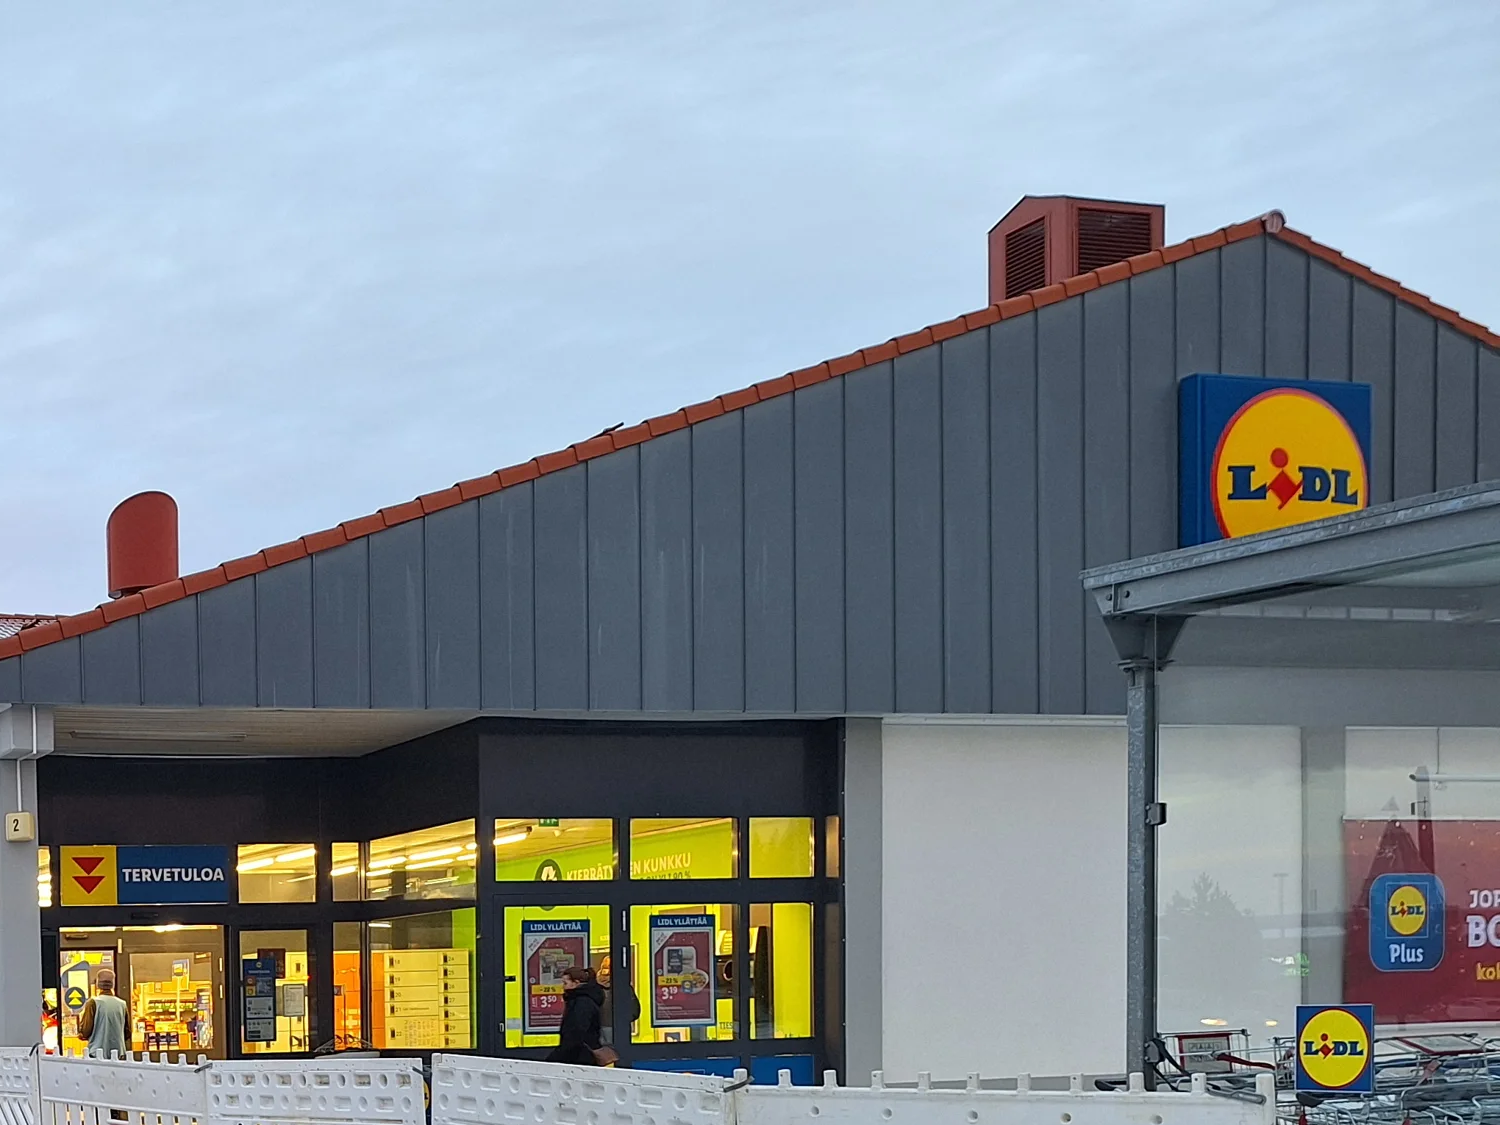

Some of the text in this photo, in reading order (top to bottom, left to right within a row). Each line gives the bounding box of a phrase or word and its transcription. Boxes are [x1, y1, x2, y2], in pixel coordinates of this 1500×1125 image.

[13, 818, 20, 832] 2
[643, 852, 691, 873] KUNKKU
[122, 867, 224, 883] TERVETULOA
[530, 921, 581, 931] LIDL YLLÄTTÄÄ
[674, 917, 707, 926] YLLÄTTÄÄ
[1389, 943, 1424, 963] Plus
